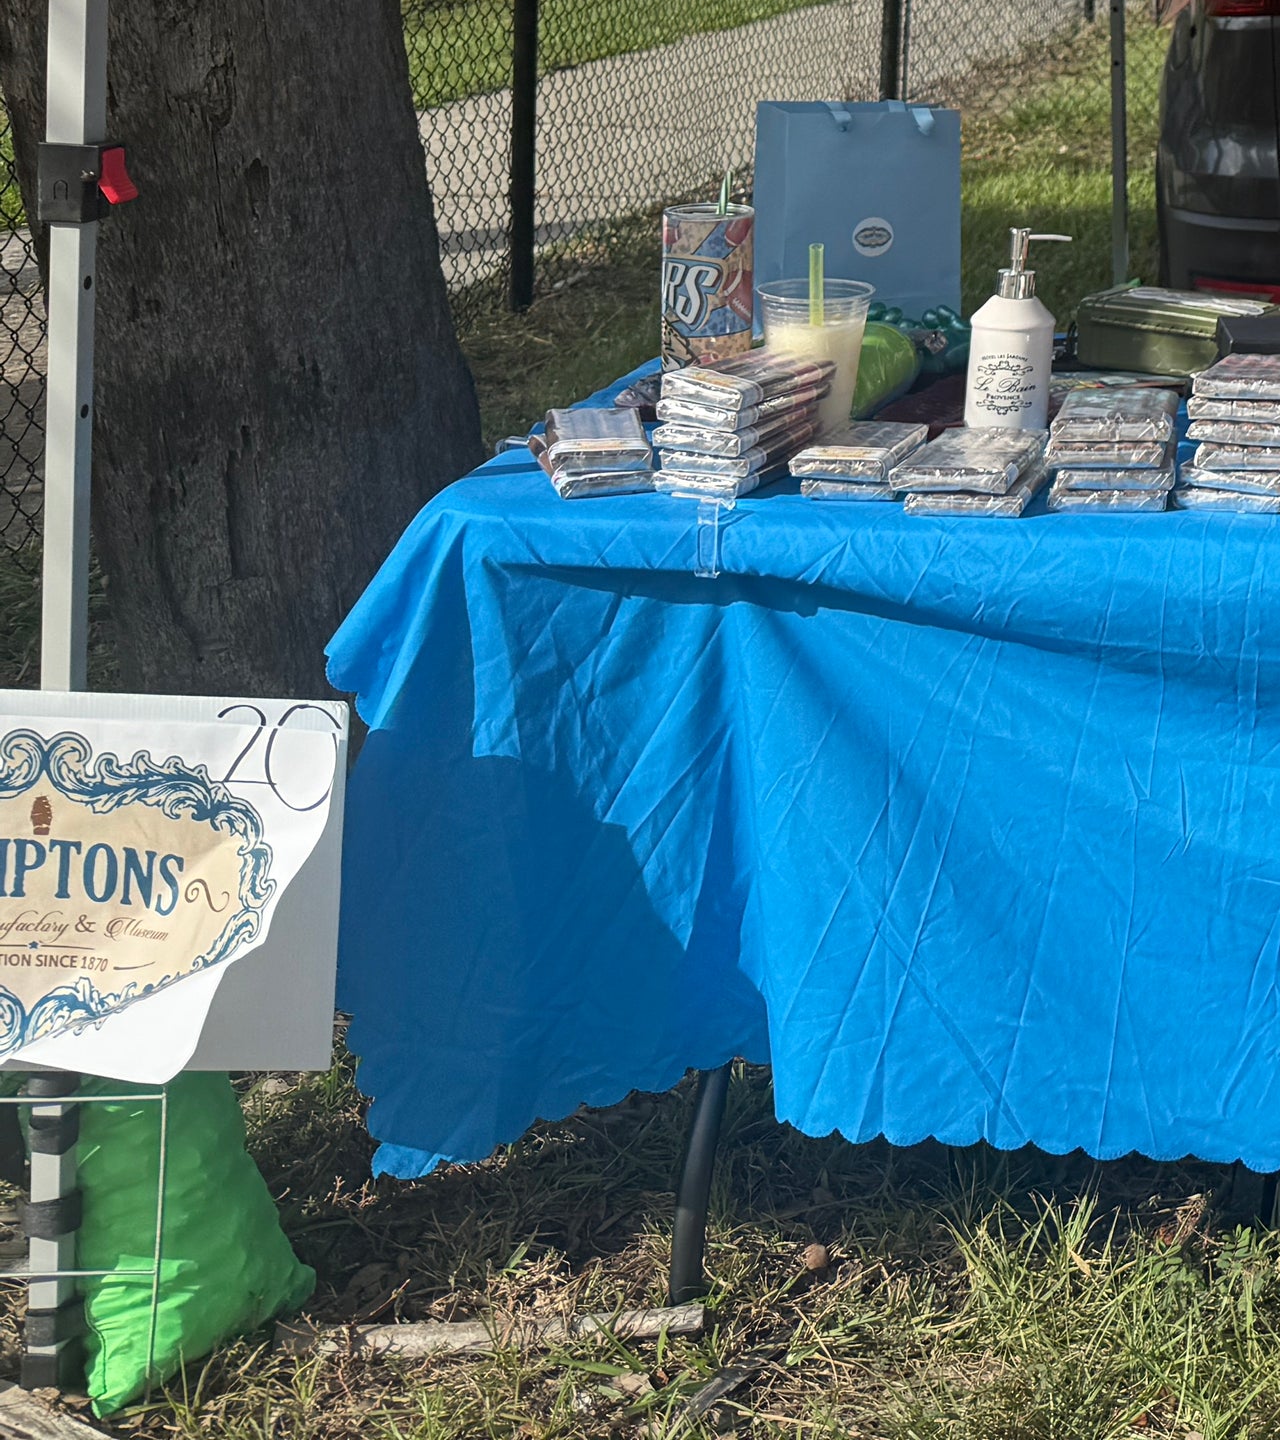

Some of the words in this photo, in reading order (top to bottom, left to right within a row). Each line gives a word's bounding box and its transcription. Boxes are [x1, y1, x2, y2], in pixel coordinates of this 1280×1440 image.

[974, 375, 994, 391] Le
[996, 377, 1037, 392] Bain
[214, 704, 342, 811] 20
[74, 914, 97, 933] &
[103, 916, 170, 941] Museum
[35, 954, 78, 969] SINCE
[81, 956, 109, 972] 1870
